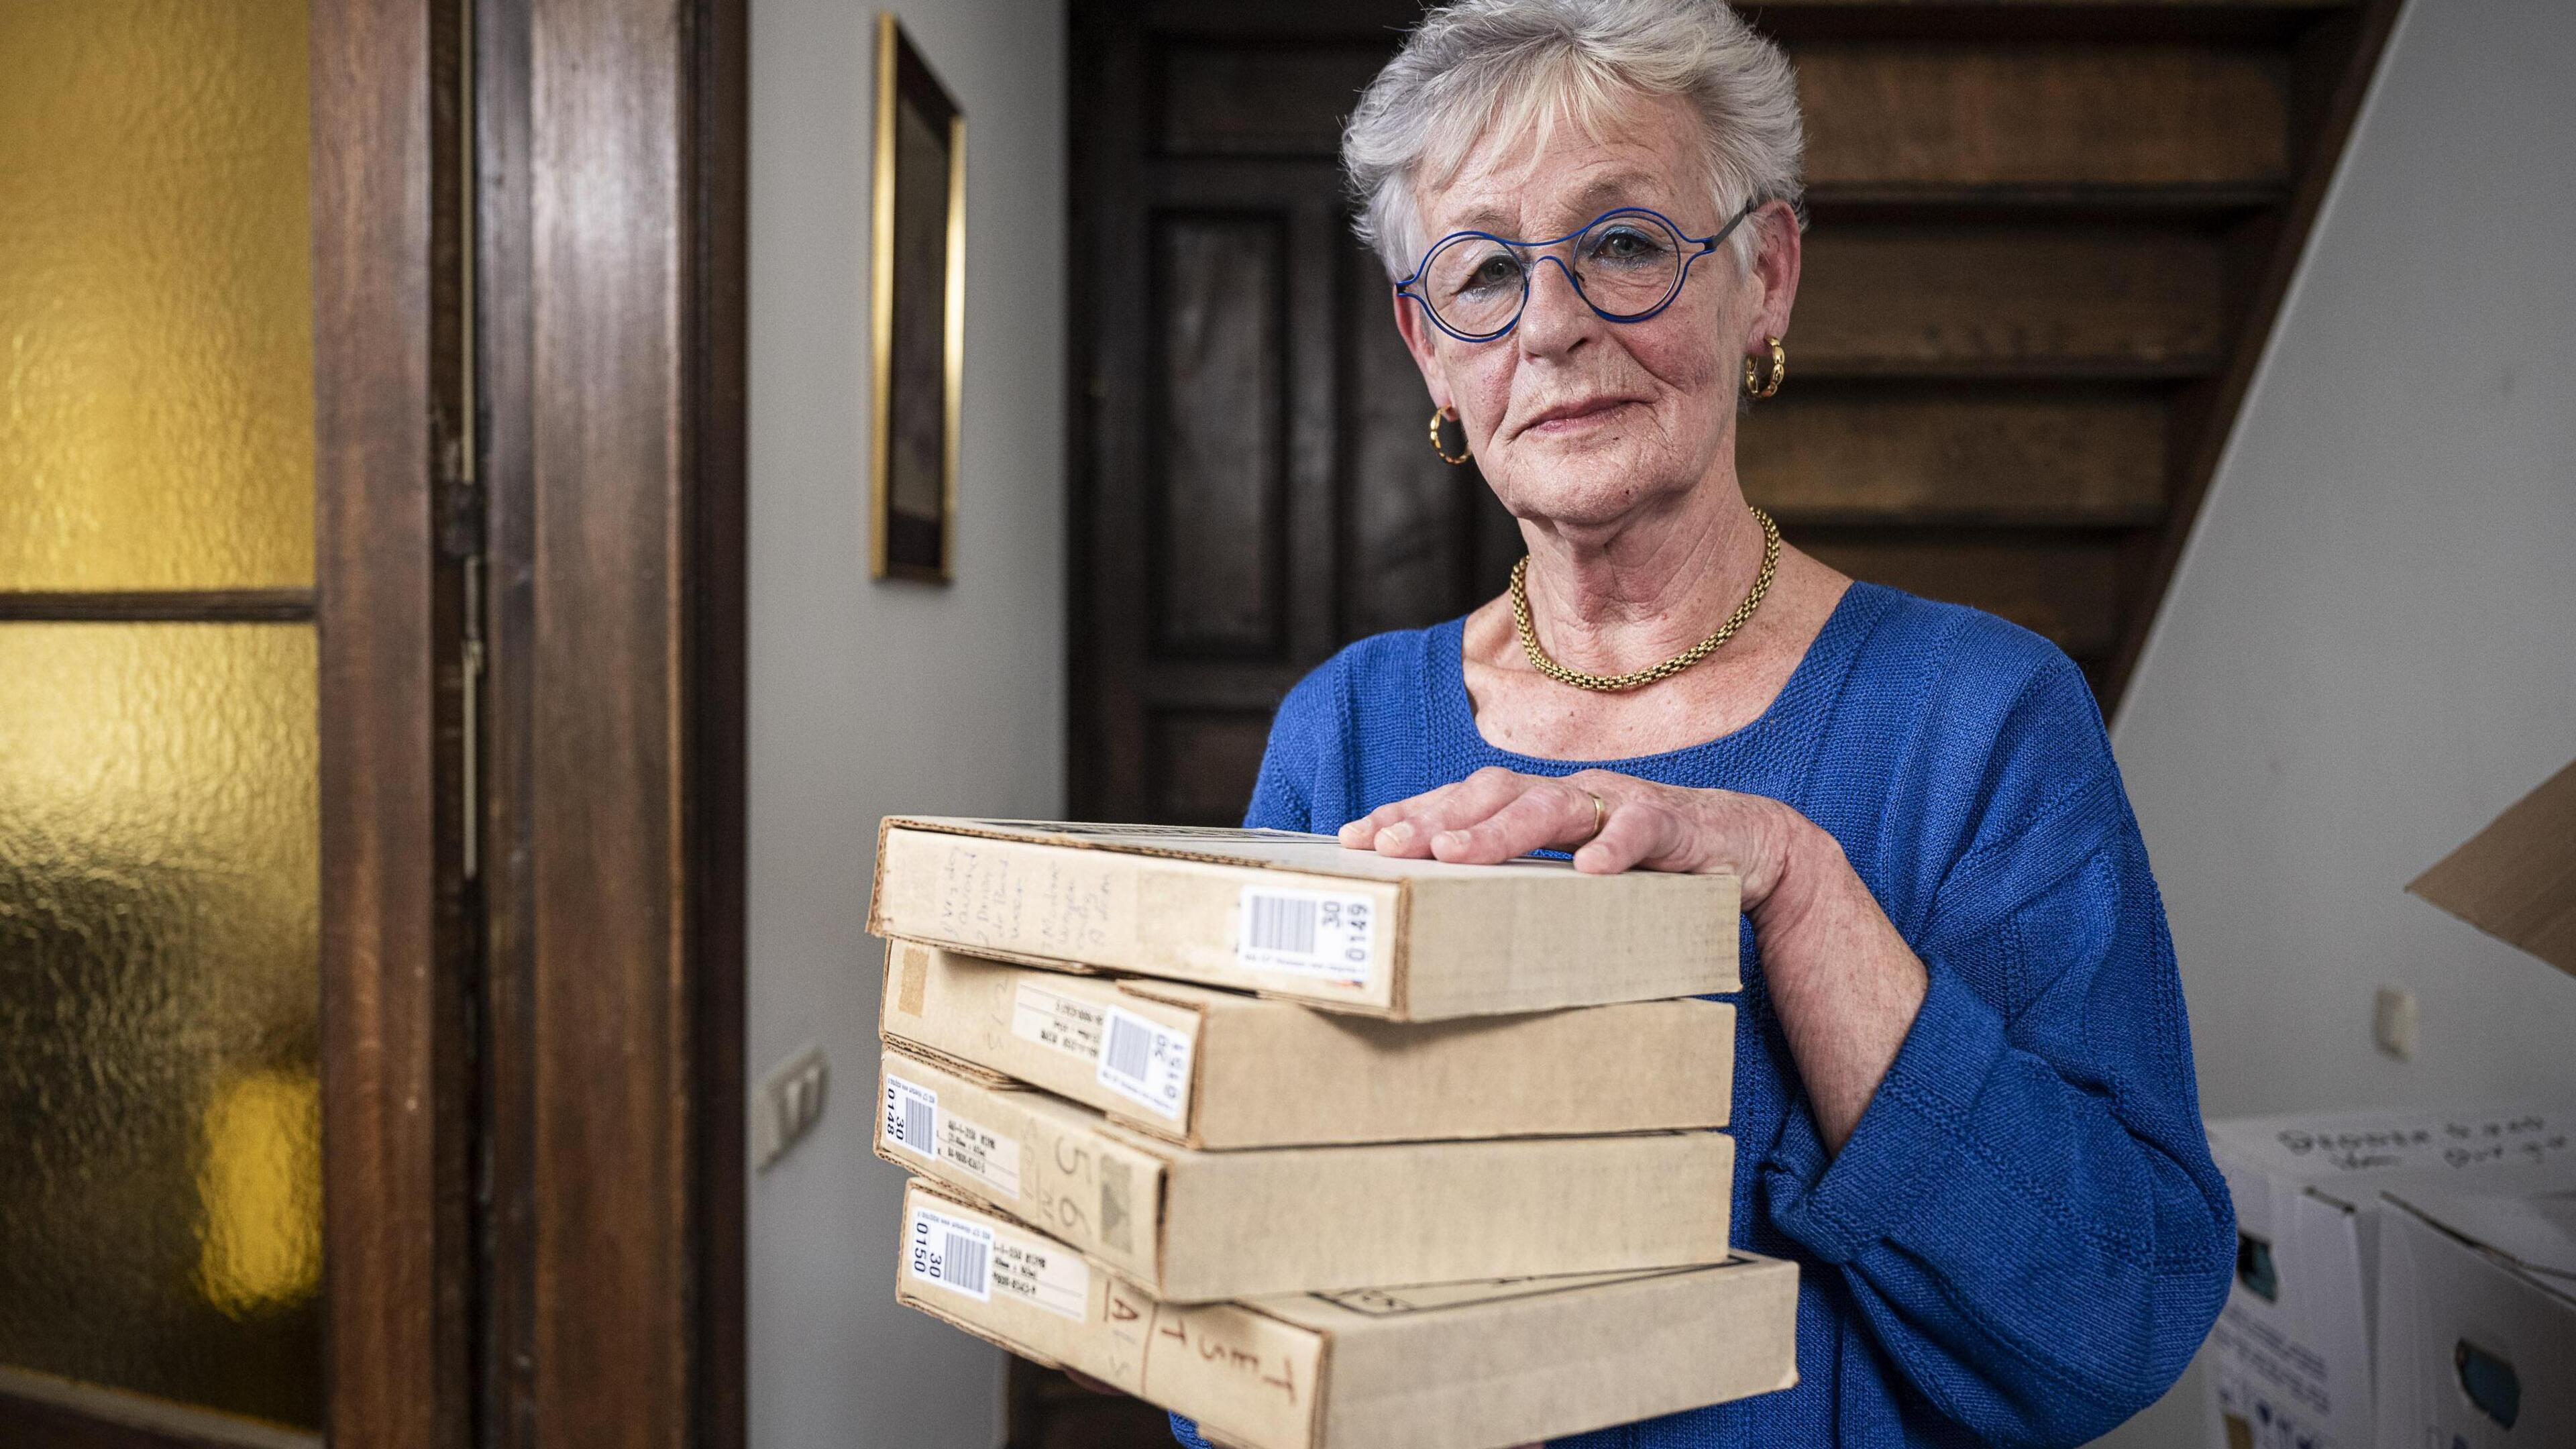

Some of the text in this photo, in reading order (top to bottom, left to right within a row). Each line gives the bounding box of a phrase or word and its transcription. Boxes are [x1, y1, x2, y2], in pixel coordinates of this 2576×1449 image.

[1322, 901, 1340, 928] 30
[1346, 904, 1367, 961] 0149
[887, 1087, 896, 1135] 0148
[896, 1116, 904, 1140] 30
[914, 1222, 929, 1273] 0150
[929, 1252, 943, 1278] 30
